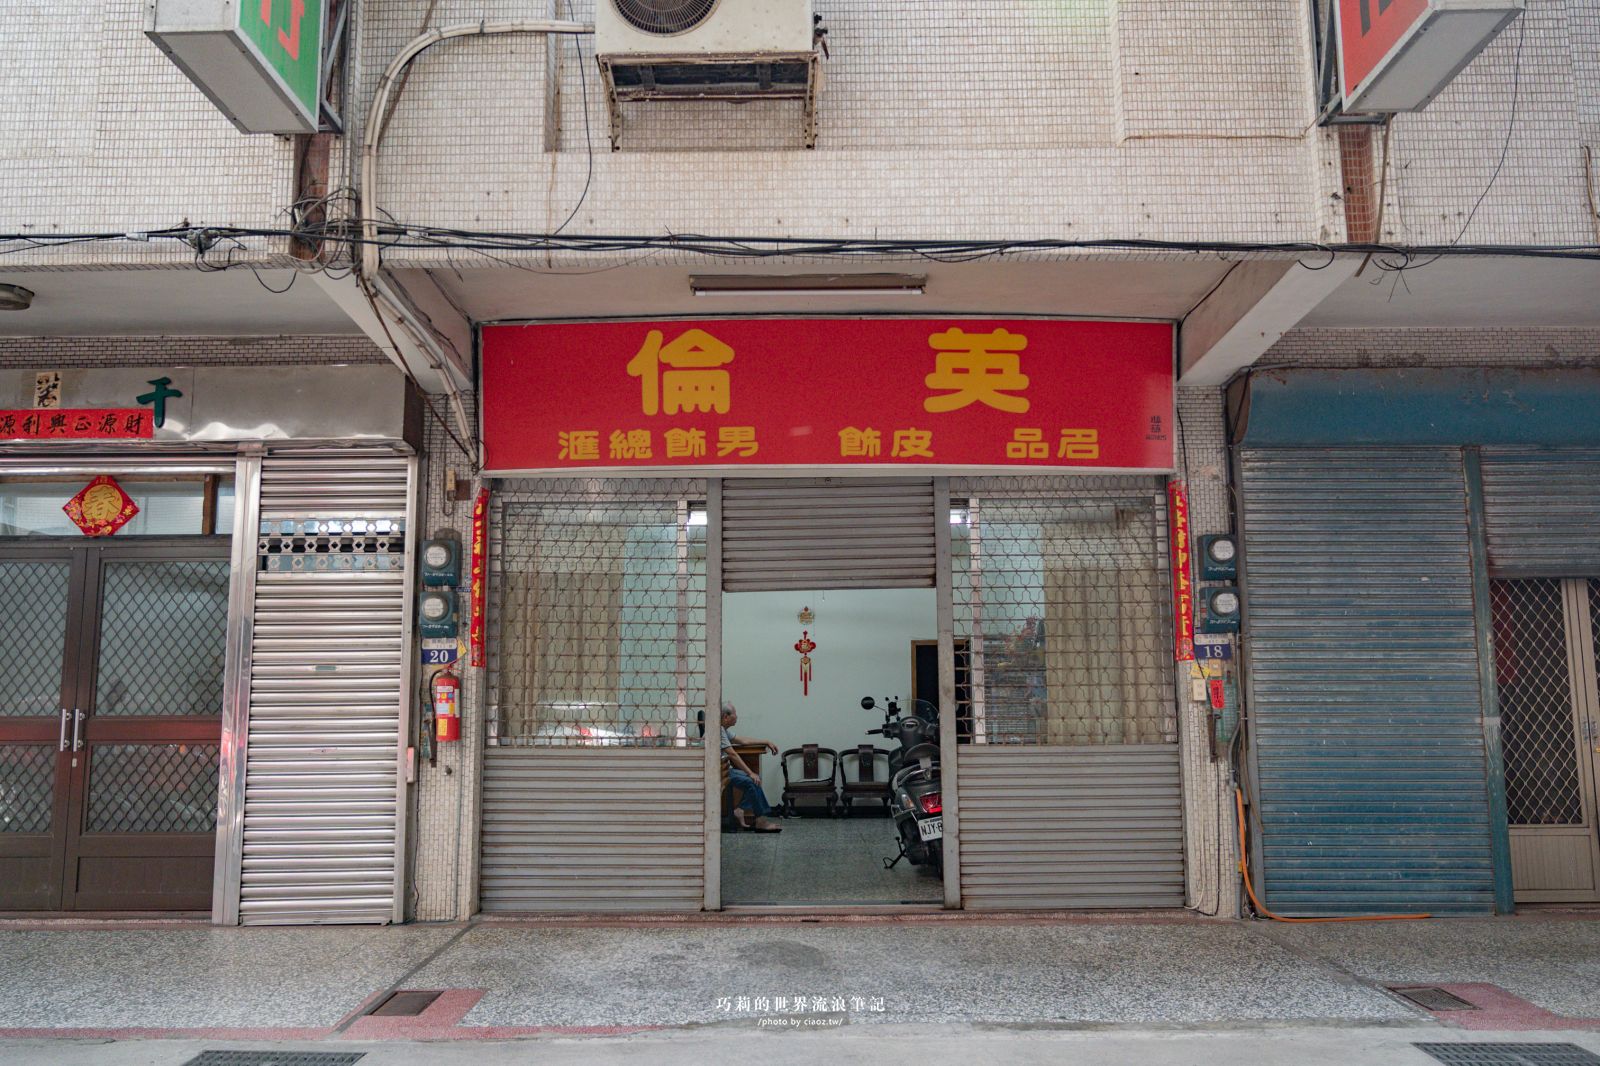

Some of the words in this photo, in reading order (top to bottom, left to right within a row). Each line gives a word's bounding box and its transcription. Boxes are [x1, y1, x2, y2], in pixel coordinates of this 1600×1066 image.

[838, 426, 934, 458] 皮飾
[1006, 428, 1099, 459] 名品
[84, 486, 120, 520] 春
[429, 649, 449, 663] 20
[1204, 645, 1224, 658] 18
